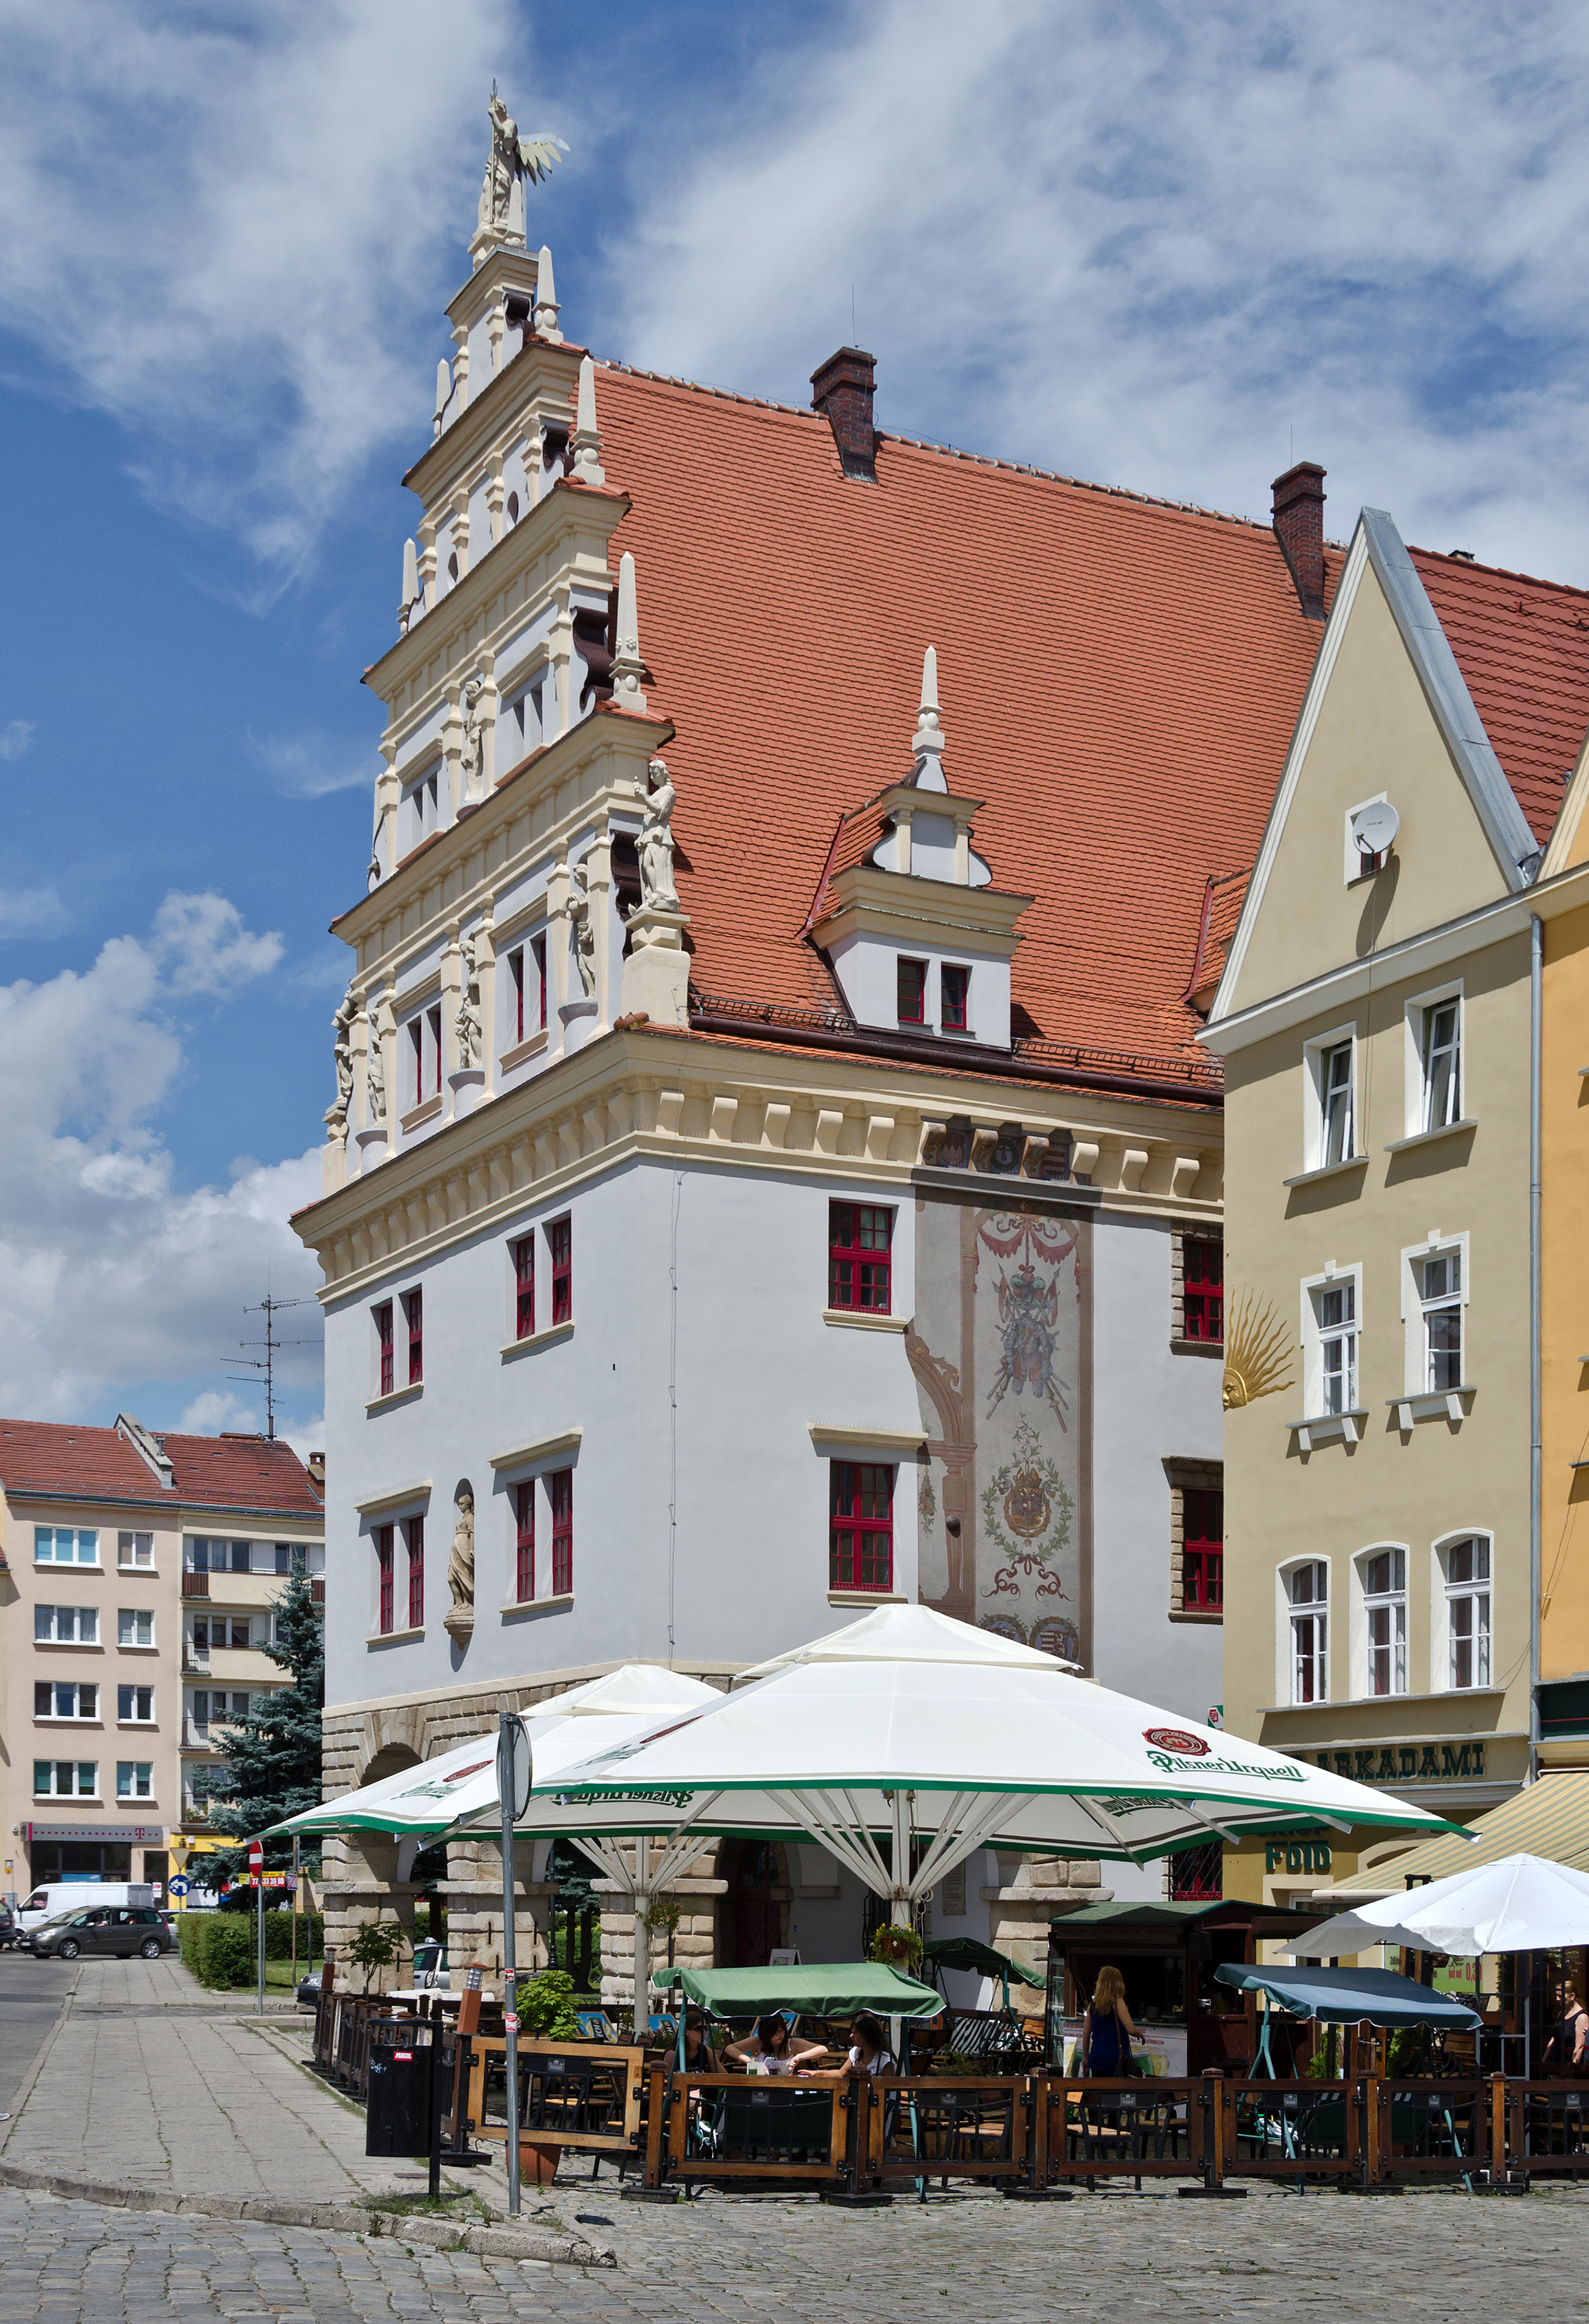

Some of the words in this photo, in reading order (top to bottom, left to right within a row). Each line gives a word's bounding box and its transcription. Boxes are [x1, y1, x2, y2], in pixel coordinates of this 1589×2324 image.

[1145, 1751, 1223, 1773] Pilsner
[1217, 1758, 1305, 1780] Urquell
[1317, 1743, 1484, 1782] ARKADAMI
[134, 1827, 145, 1839] T
